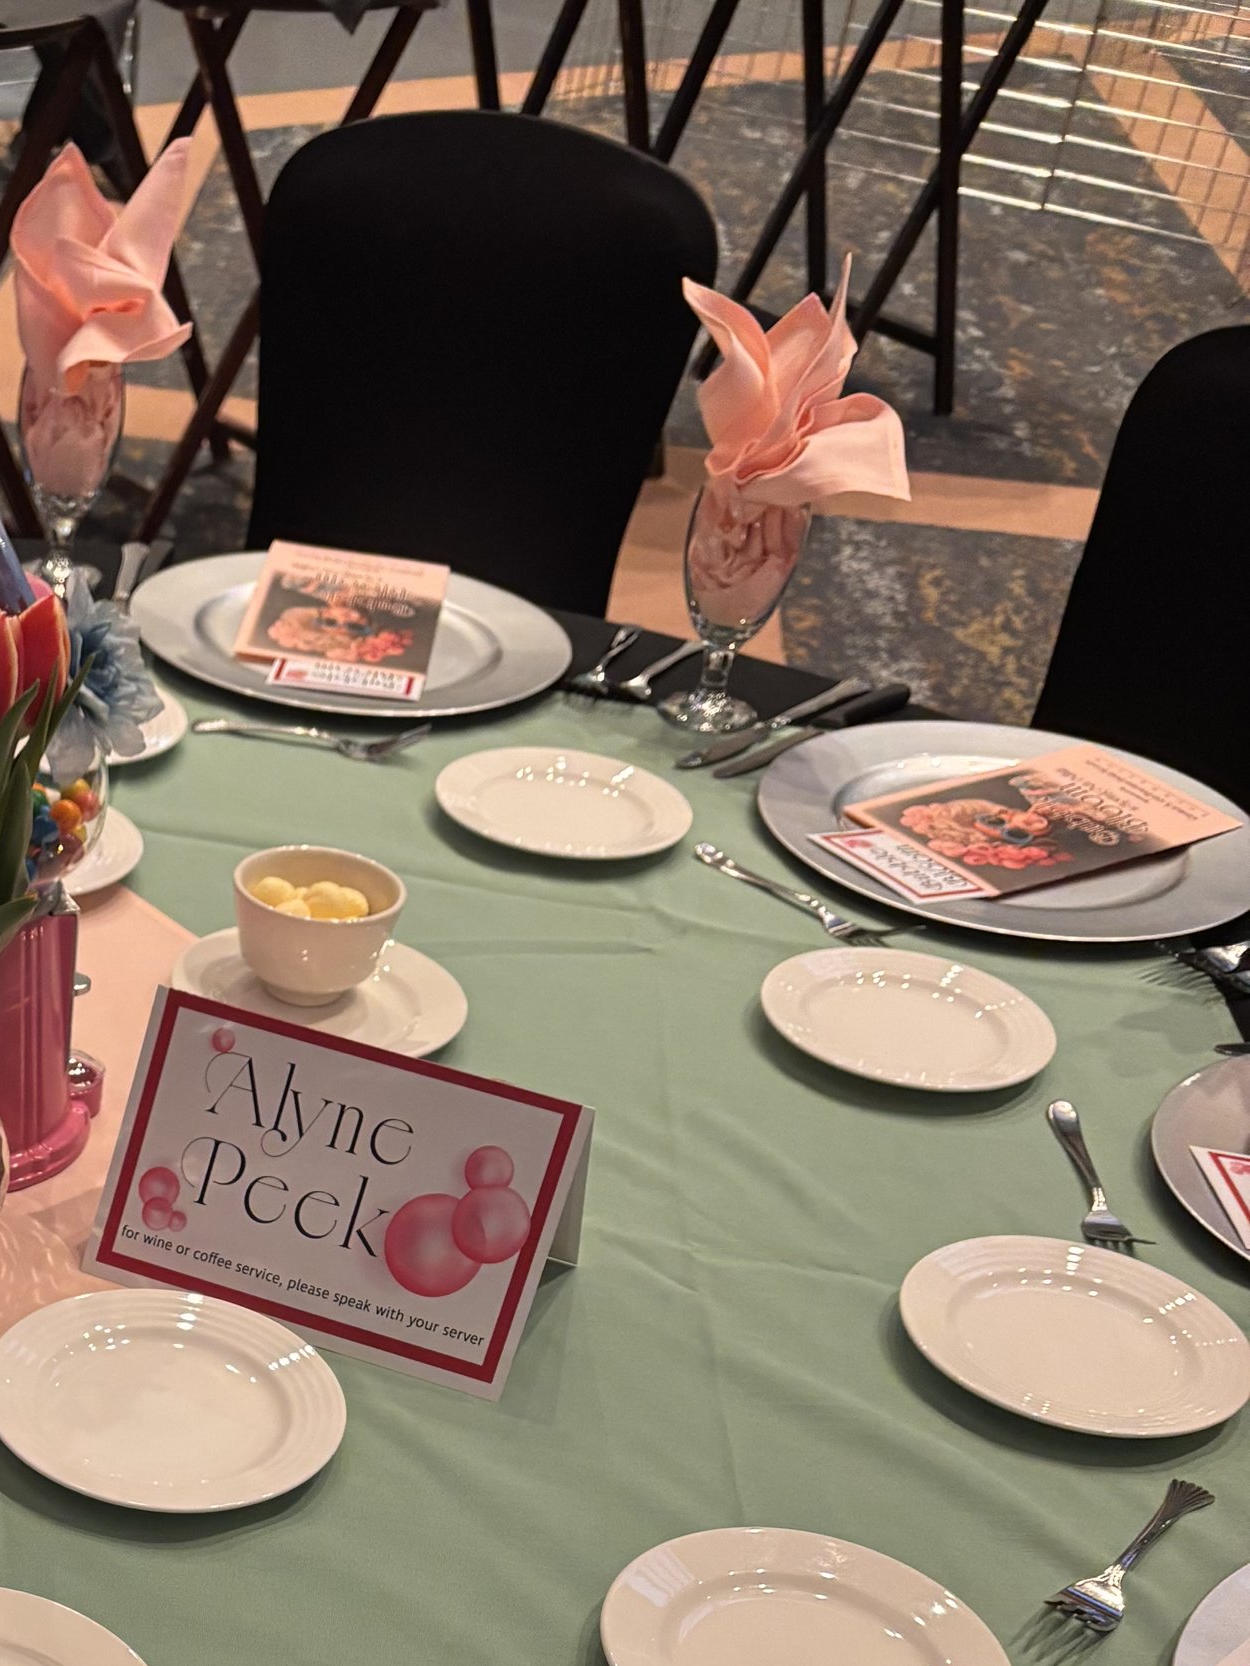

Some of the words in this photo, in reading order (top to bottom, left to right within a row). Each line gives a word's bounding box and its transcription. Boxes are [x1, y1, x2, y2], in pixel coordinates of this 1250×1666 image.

[204, 1050, 414, 1165] Alyne
[180, 1136, 391, 1257] Peek
[121, 1224, 140, 1240] for
[143, 1232, 173, 1251] wine
[176, 1243, 191, 1256] or
[193, 1248, 233, 1270] coffee
[235, 1261, 284, 1288] service,
[286, 1277, 330, 1300] please
[333, 1291, 372, 1312] speak
[375, 1304, 404, 1322] with
[406, 1315, 440, 1333] your
[442, 1325, 485, 1346] server
